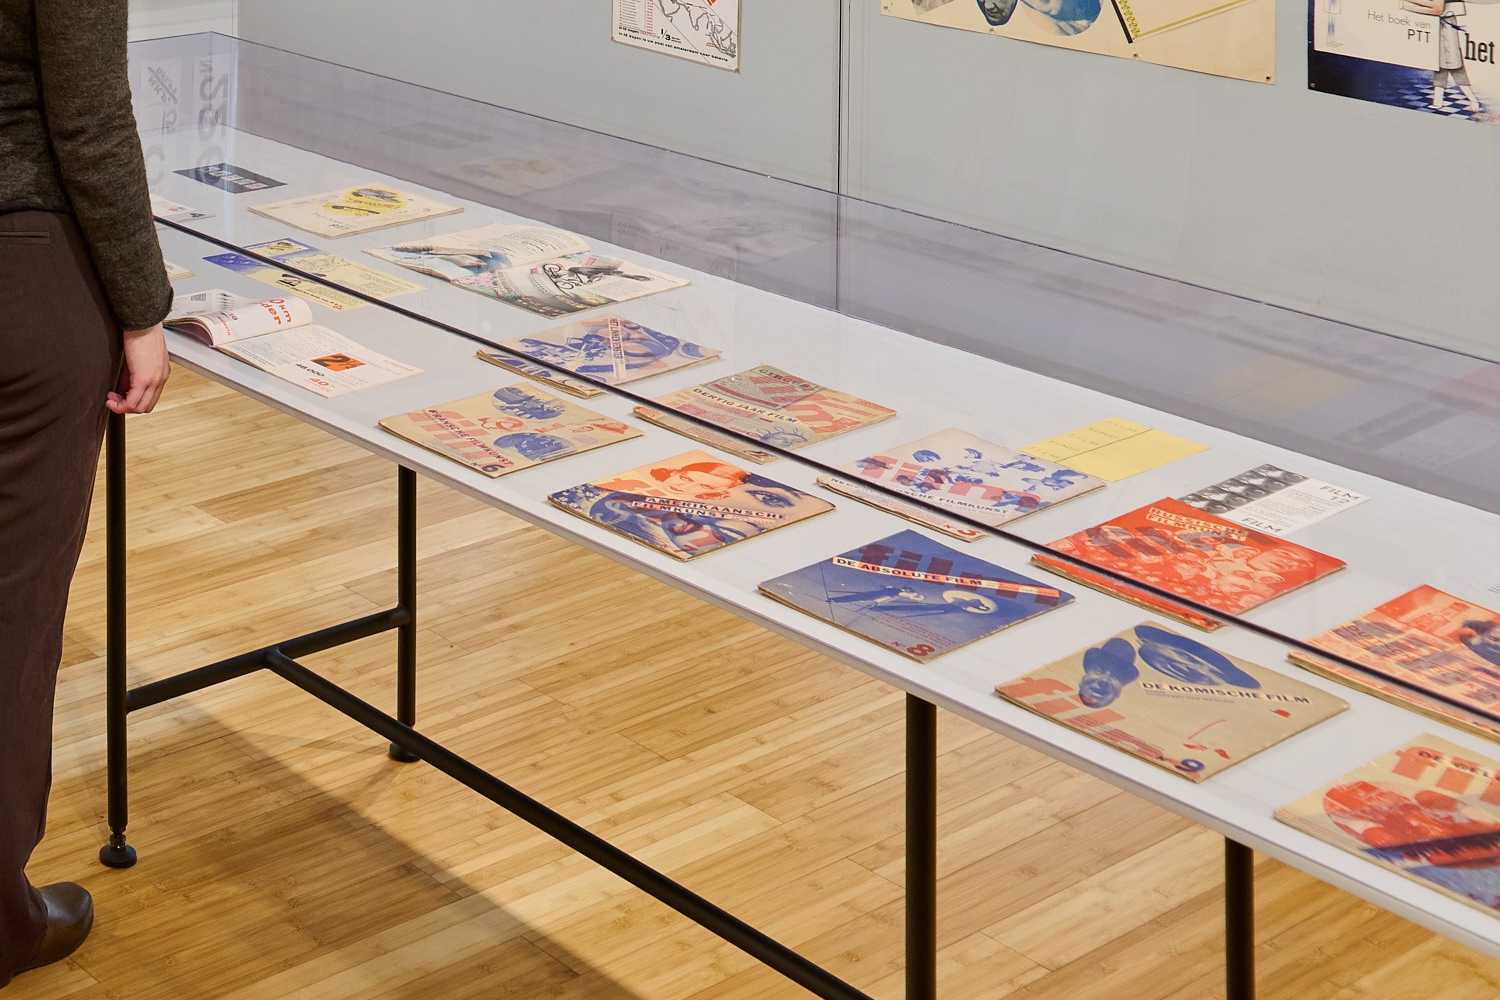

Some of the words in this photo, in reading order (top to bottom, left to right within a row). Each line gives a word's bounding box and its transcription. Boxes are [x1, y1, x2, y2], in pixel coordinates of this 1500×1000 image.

[1367, 10, 1384, 22] Het
[1388, 13, 1411, 27] boek
[1415, 20, 1431, 30] van
[1407, 29, 1431, 43] PTT
[1465, 33, 1495, 65] het
[693, 388, 735, 406] DERTIG
[736, 405, 765, 414] JAAR
[768, 412, 797, 423] FILM
[429, 409, 470, 438] FRANSCHE
[467, 437, 513, 465] FILMKUNST
[1320, 486, 1360, 500] FILM
[634, 502, 726, 518] FILMKUNST
[649, 497, 787, 519] AMERIKAANSCHE
[939, 497, 1009, 514] FILMKUNST
[1241, 517, 1282, 533] FILM
[836, 558, 856, 567] DE
[861, 564, 940, 581] ABSOLUTE
[945, 576, 982, 586] FILM
[906, 643, 935, 657] 8
[1143, 682, 1165, 690] DE
[1169, 685, 1262, 700] KOMISCHE
[1265, 694, 1311, 704] FILM
